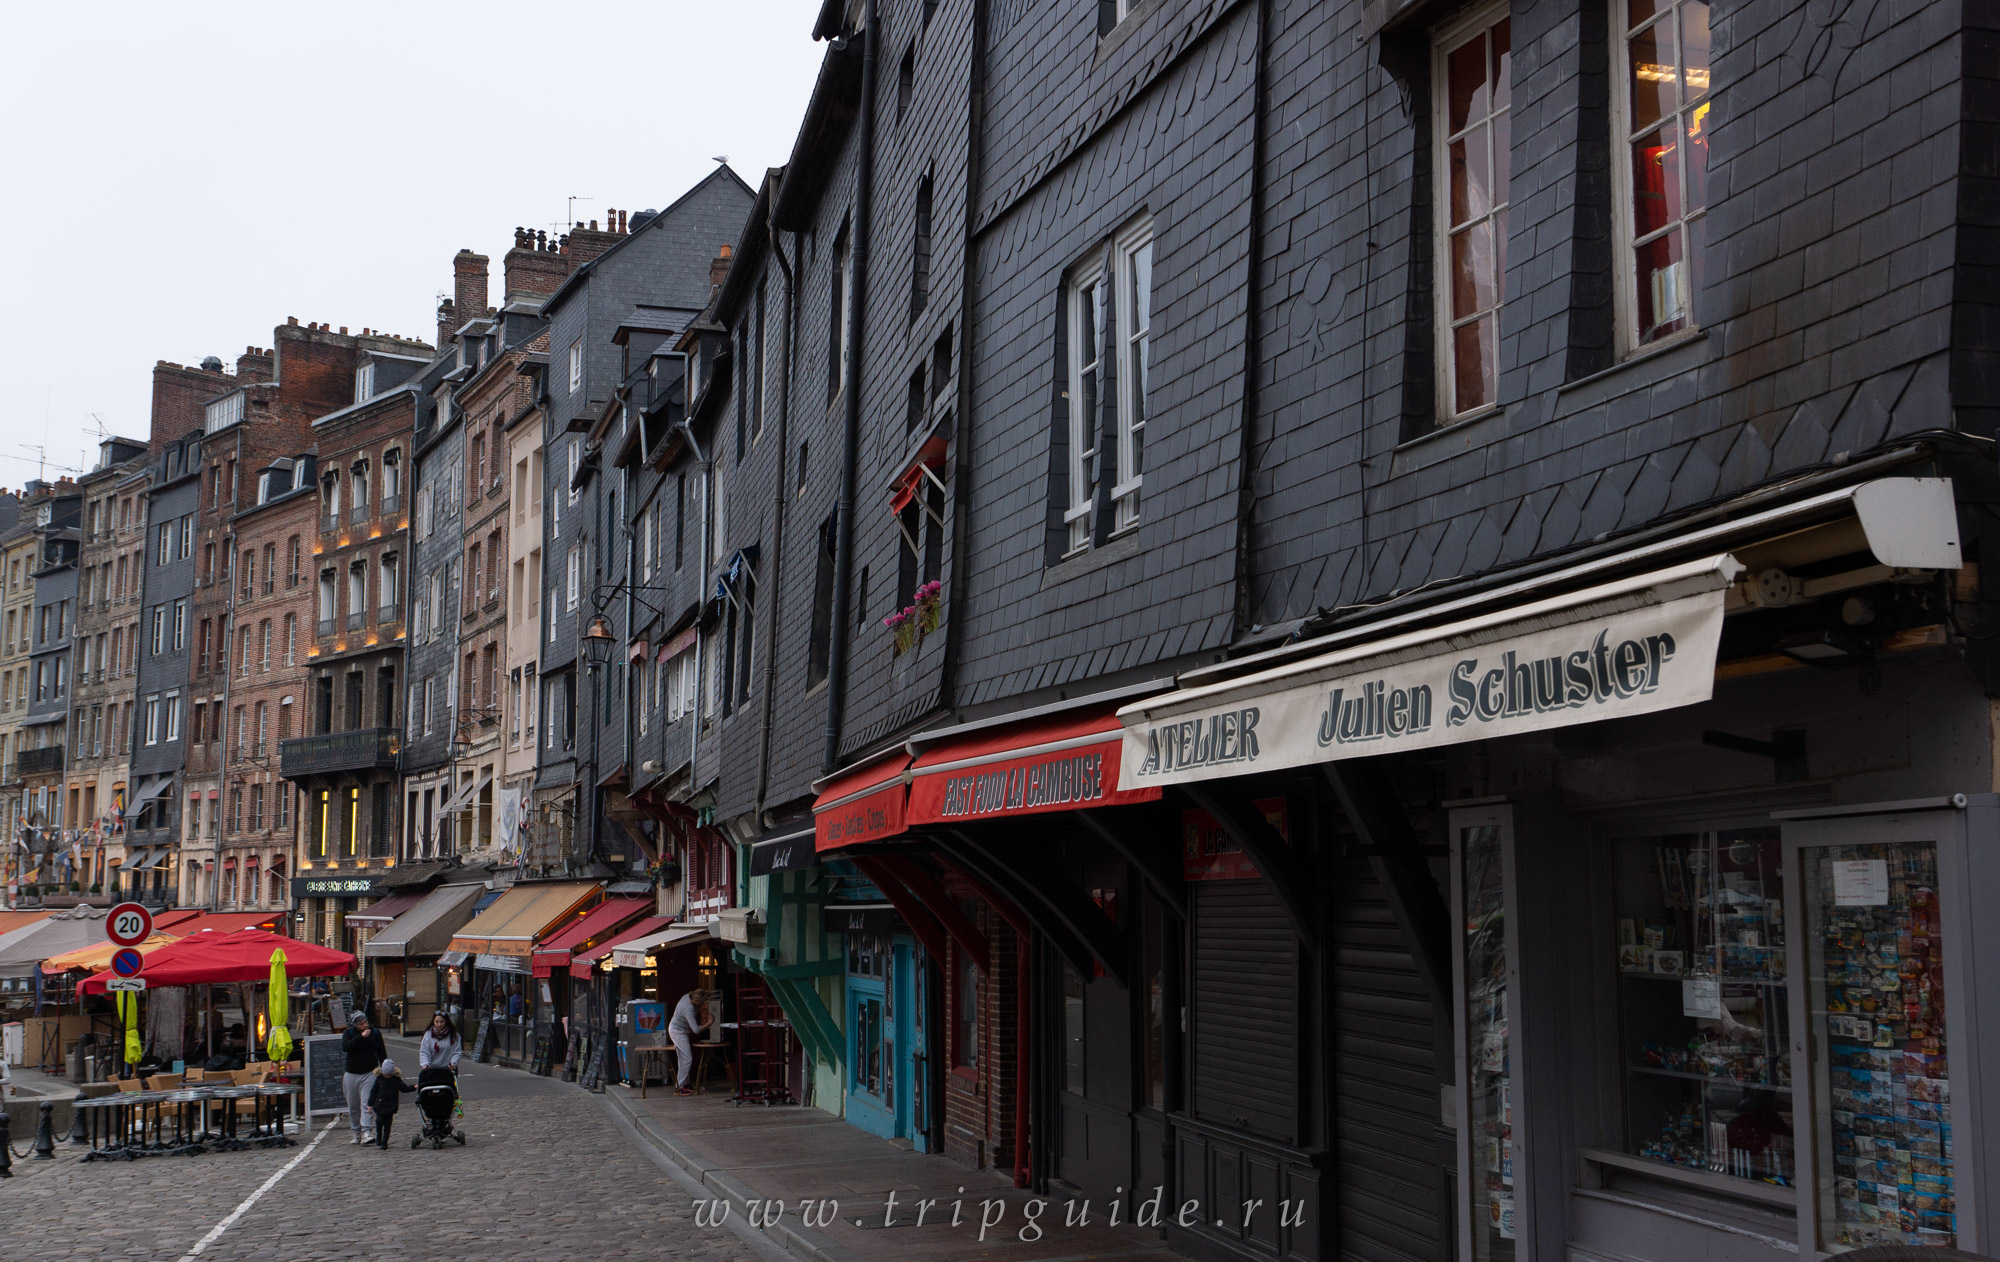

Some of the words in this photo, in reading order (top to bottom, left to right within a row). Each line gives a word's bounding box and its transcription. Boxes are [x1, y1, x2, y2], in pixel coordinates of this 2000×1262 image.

[1138, 707, 1262, 776] ATELIER
[1317, 680, 1433, 747] Julien
[1446, 628, 1676, 726] Schuster
[942, 776, 975, 816] FAST
[972, 770, 1007, 814] FOOD
[1006, 767, 1026, 810] LA
[1026, 752, 1103, 808] CAMBUSE
[119, 916, 139, 933] 20
